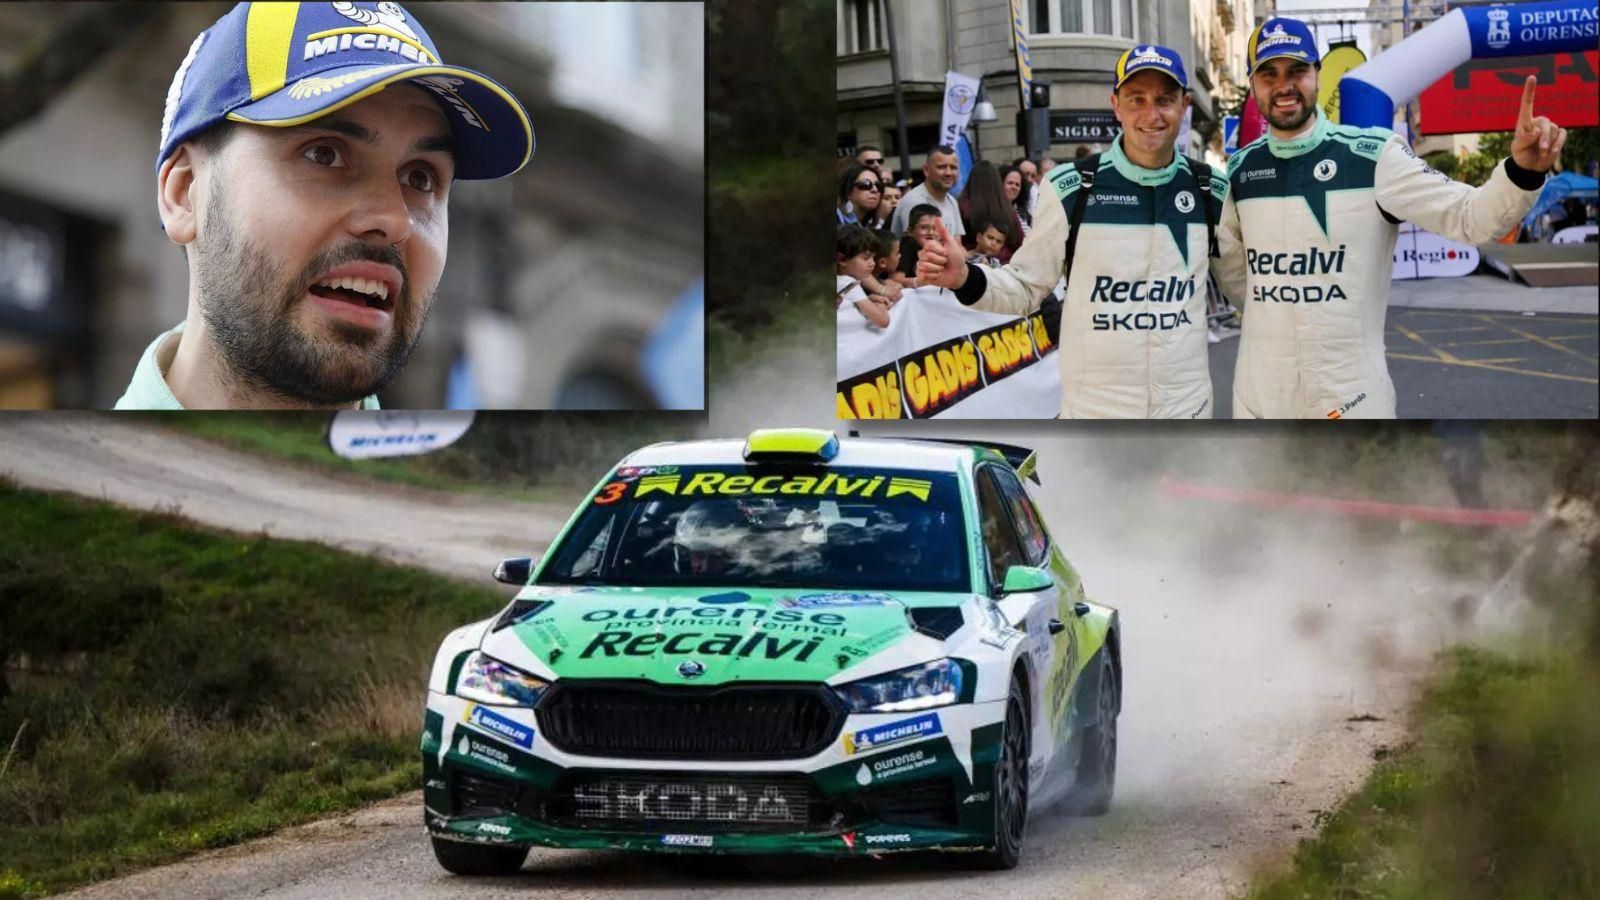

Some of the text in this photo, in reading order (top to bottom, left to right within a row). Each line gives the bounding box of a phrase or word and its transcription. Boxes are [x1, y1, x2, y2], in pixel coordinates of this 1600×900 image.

[303, 33, 437, 65] MICHEL
[1055, 125, 1102, 138] SIGLO
[1357, 142, 1378, 152] OMP
[1058, 176, 1080, 190] OMP
[1247, 168, 1276, 178] ourense
[1096, 194, 1138, 203] ourense
[1246, 244, 1346, 276] Recalvi
[904, 340, 978, 413] GADIS
[978, 321, 1034, 374] GADIS
[594, 482, 628, 504] 3
[680, 472, 886, 498] Recalvi
[582, 606, 846, 626] ourense
[604, 616, 741, 631] provincia
[579, 631, 824, 662] Recalvi
[481, 715, 527, 741] MICHELIN
[873, 721, 933, 742] MICHELIN
[874, 750, 924, 772] ourense
